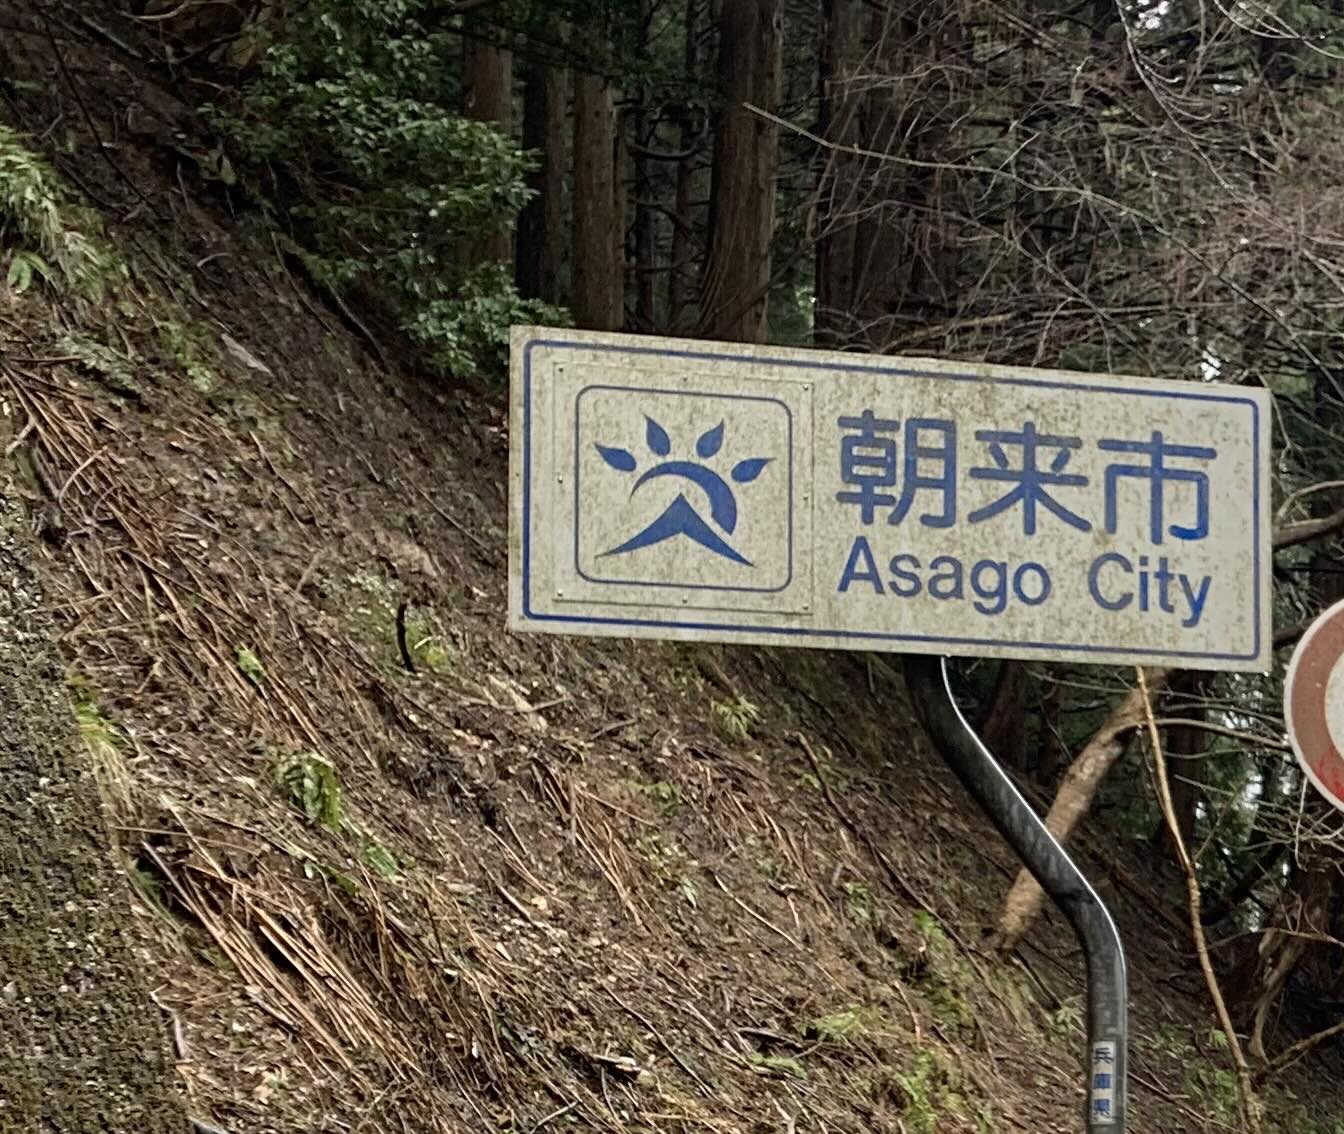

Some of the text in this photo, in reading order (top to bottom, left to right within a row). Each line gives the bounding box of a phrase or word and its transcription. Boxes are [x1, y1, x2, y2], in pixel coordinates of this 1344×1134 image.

[836, 409, 1217, 545] 朝来市
[837, 536, 1212, 629] Asago City
